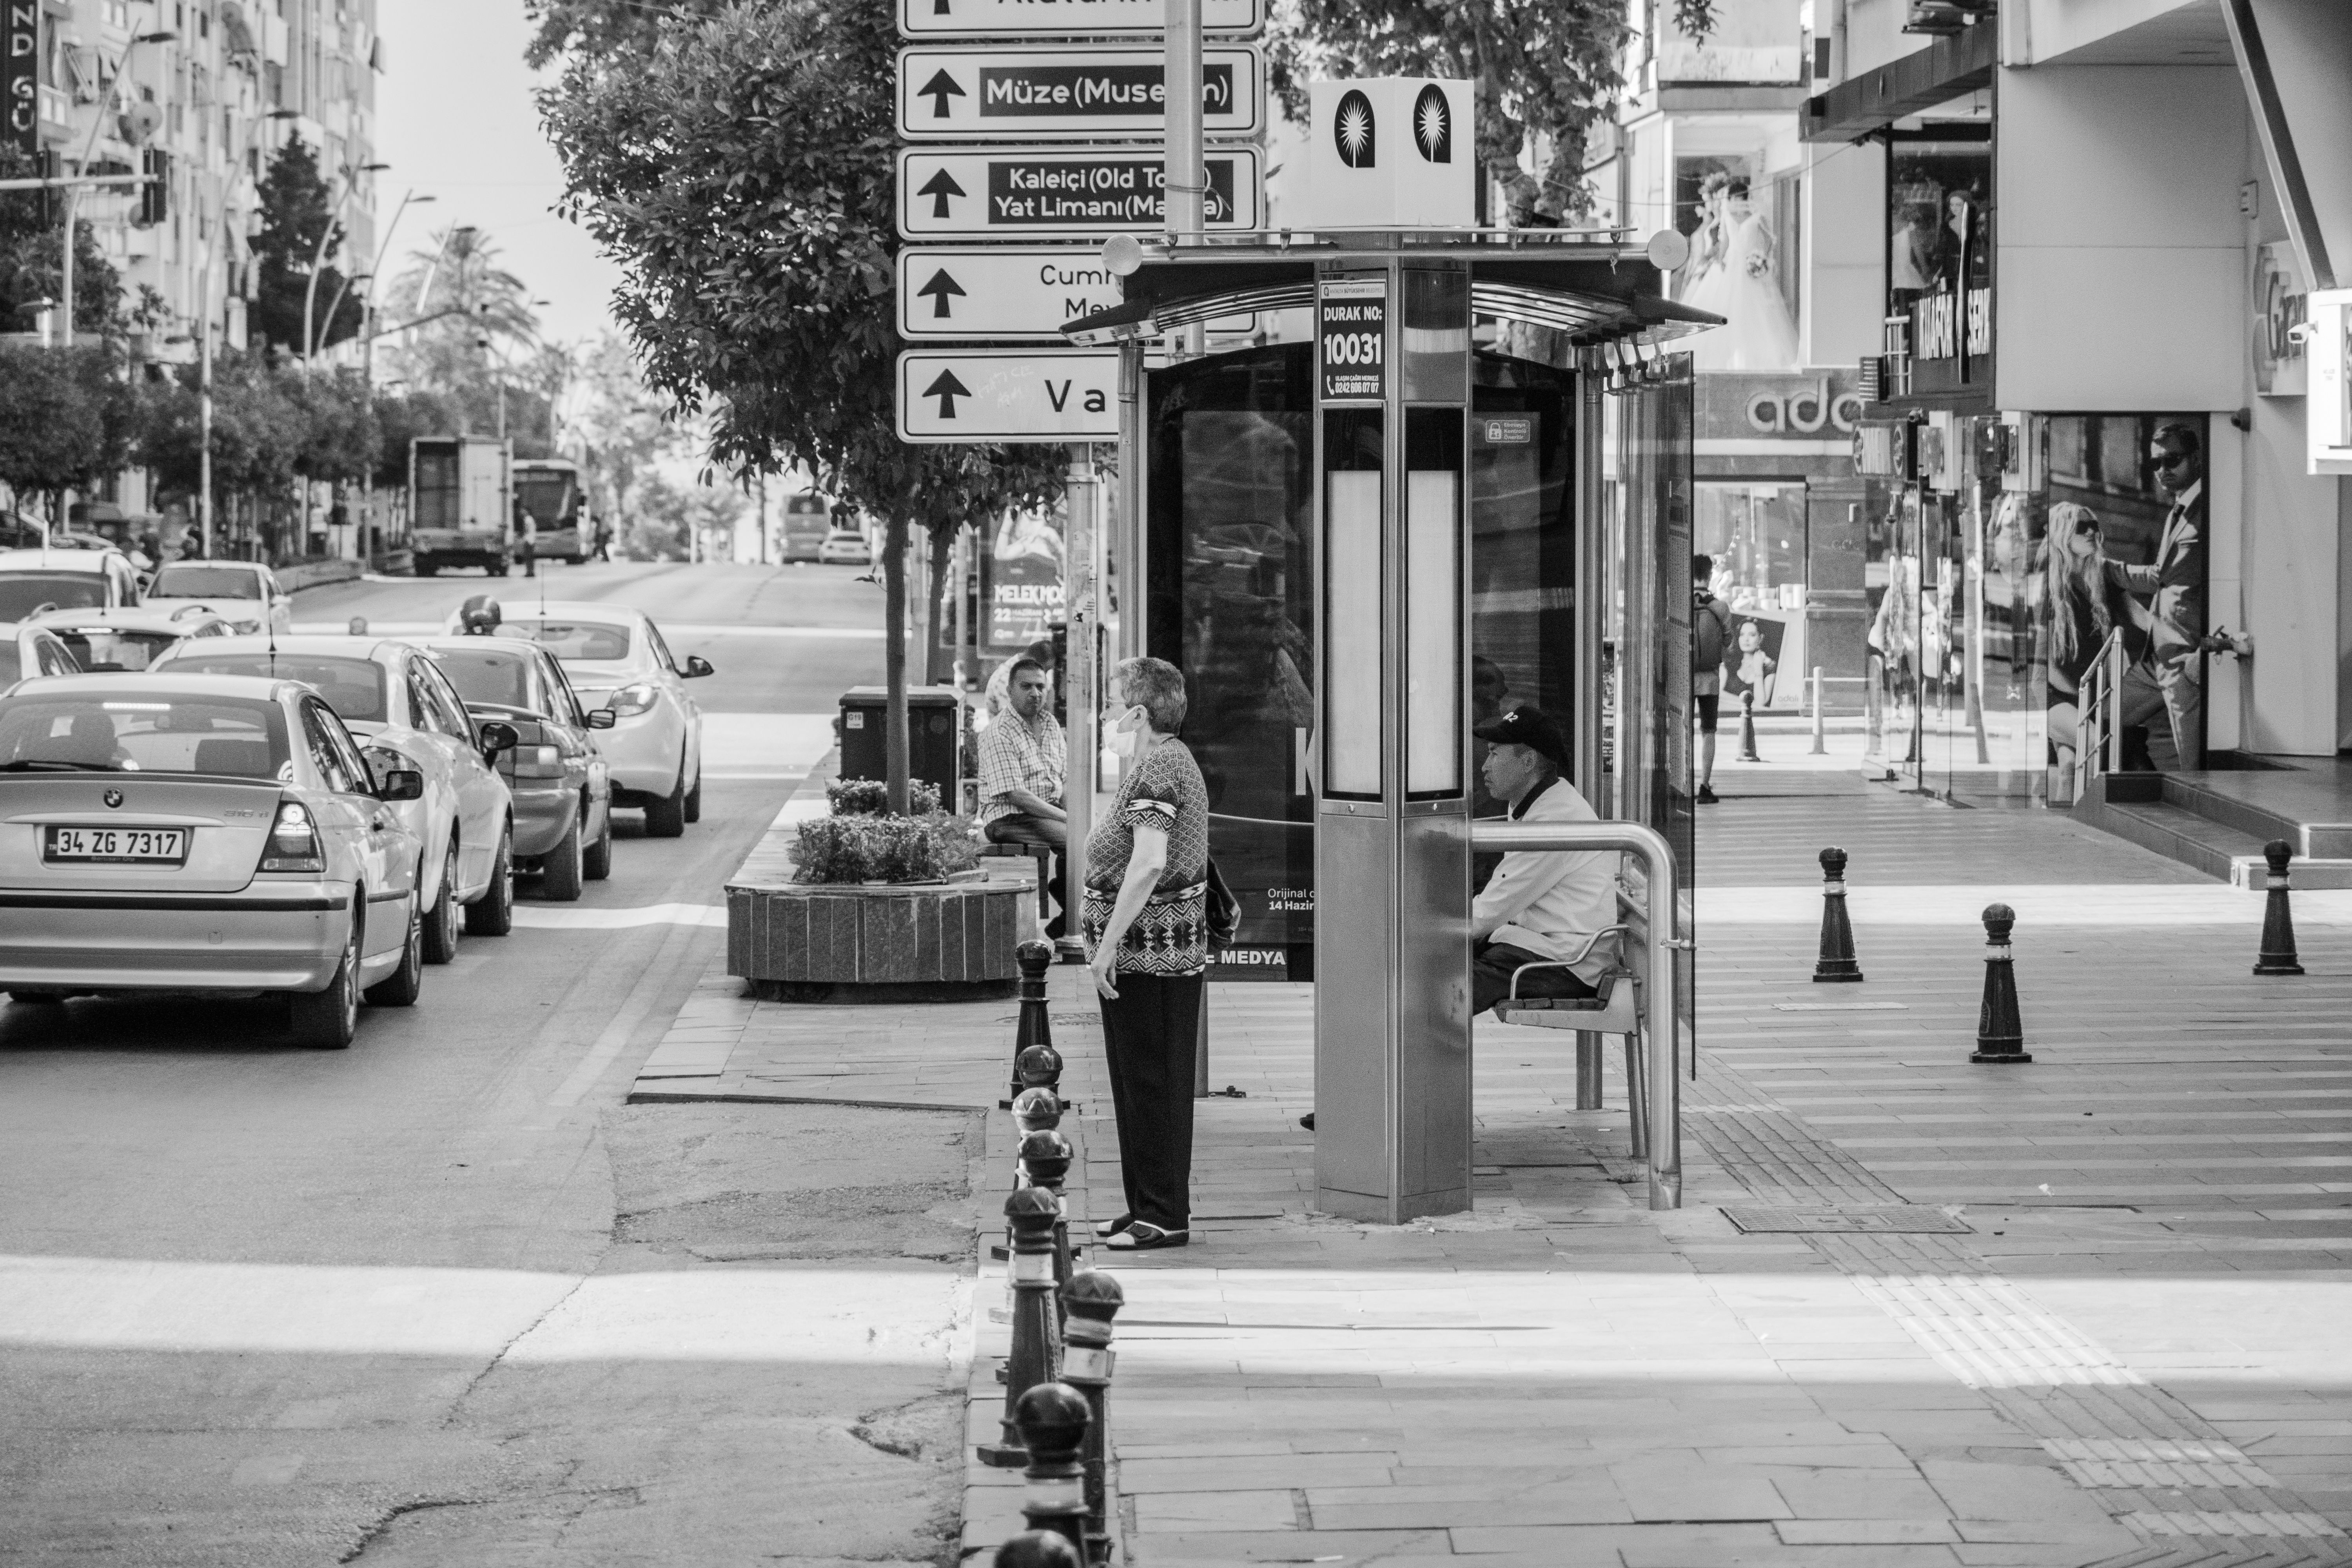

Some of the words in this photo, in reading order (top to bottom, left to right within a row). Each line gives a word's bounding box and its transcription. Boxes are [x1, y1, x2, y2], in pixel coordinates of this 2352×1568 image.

[987, 78, 1070, 104] Müze
[1074, 75, 1228, 108] (Musem)
[1010, 168, 1085, 191] Kaleiçi
[995, 196, 1034, 217] Yat
[1324, 306, 1361, 321] DURAK
[1364, 306, 1382, 320] NO:
[1324, 333, 1381, 365] 10031
[1335, 382, 1350, 393] 0242
[1350, 382, 1362, 393] 606
[1363, 382, 1370, 393] 07
[1371, 382, 1379, 393] 07
[994, 584, 1041, 605] MELEK
[994, 608, 1011, 622] 22
[60, 831, 83, 853] 34
[92, 832, 116, 853] ZG
[127, 833, 177, 855] 7317
[1268, 888, 1307, 900] Orijinal
[1269, 901, 1282, 910] 14
[1221, 951, 1286, 965] MEDYA
